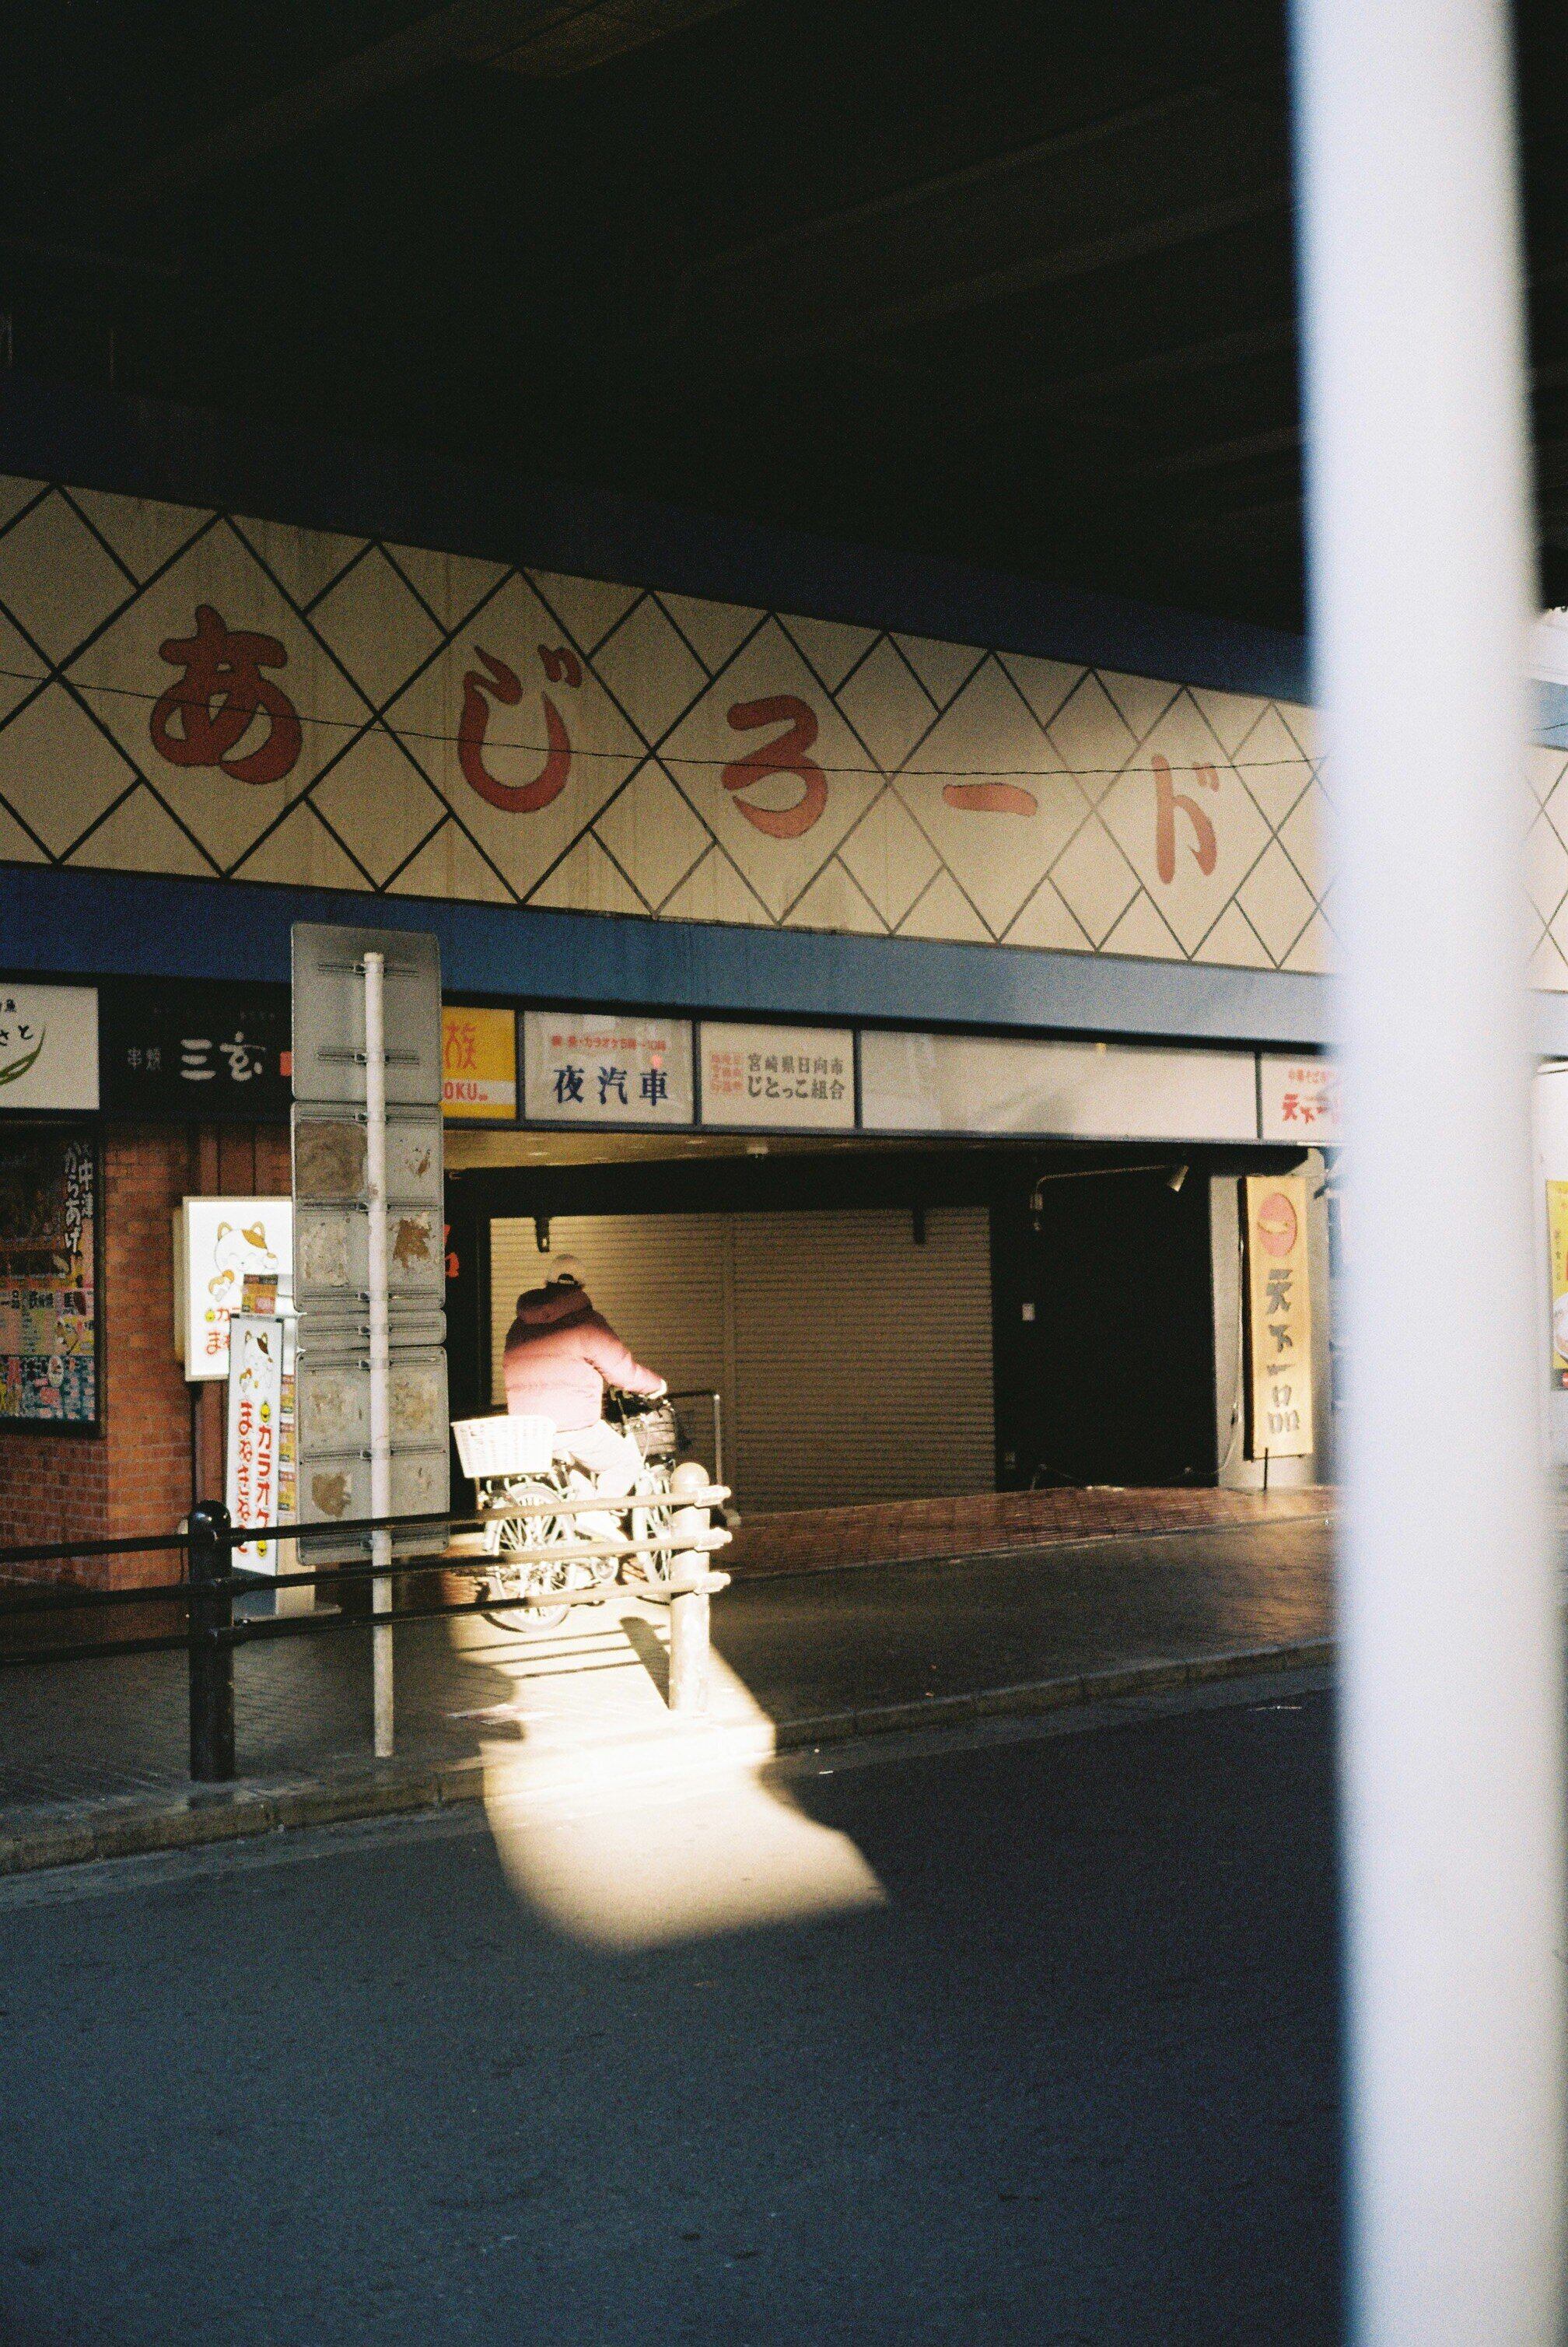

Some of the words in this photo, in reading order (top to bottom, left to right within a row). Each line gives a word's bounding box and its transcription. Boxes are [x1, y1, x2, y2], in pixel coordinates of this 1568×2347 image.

[747, 1053, 844, 1075] 宮崎県日向市
[553, 1064, 668, 1106] 夜汽車
[747, 1075, 845, 1100] じとっこ組合
[1282, 1091, 1332, 1125] 天下一
[1265, 1269, 1300, 1433] 天下一品
[256, 1425, 271, 1528] カラオケ
